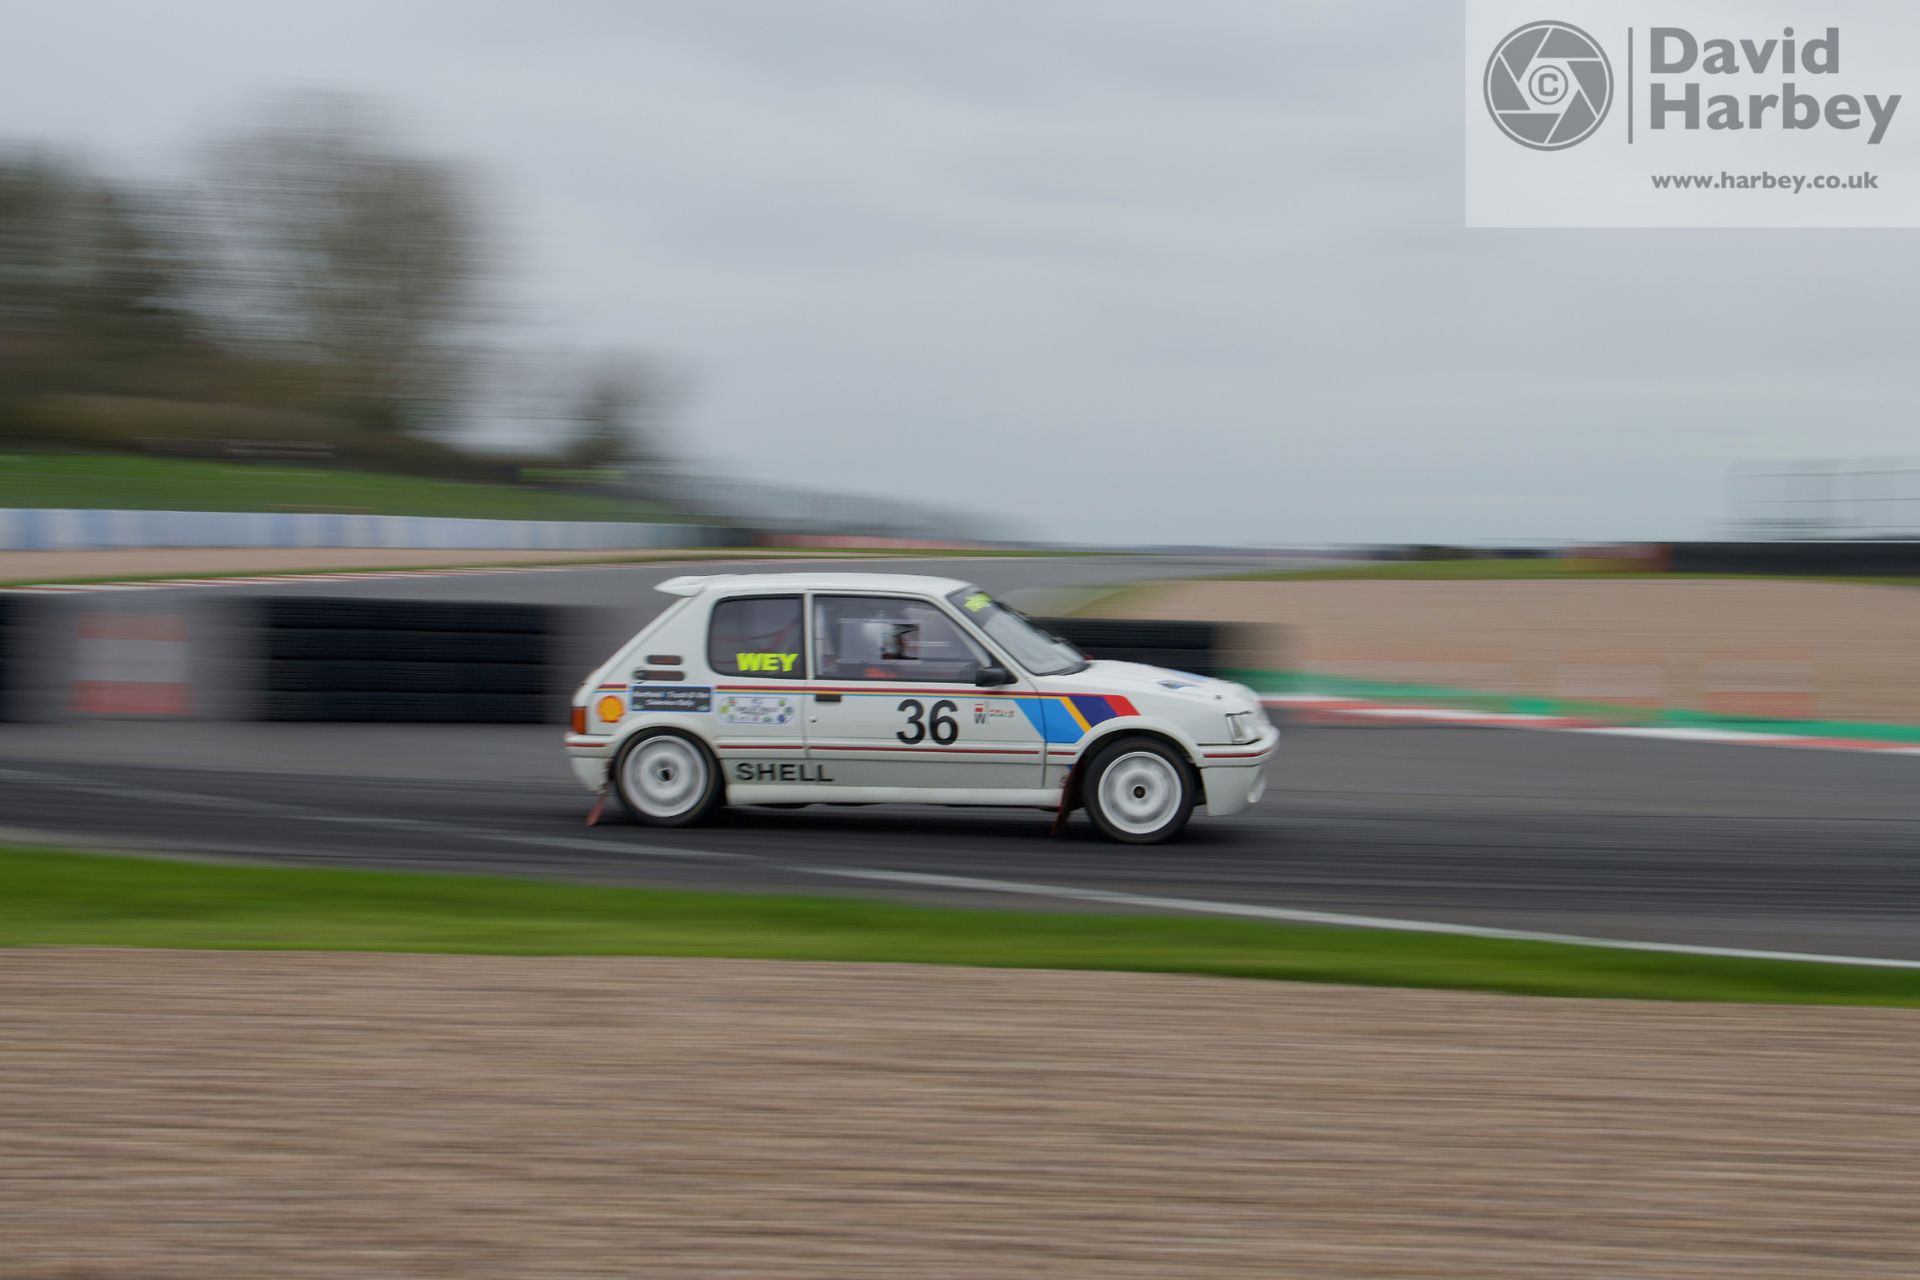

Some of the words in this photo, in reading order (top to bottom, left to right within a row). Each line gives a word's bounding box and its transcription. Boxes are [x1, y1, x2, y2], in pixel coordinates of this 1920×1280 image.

[736, 652, 799, 672] WEY
[896, 698, 959, 746] 36
[735, 762, 834, 782] SHELL
